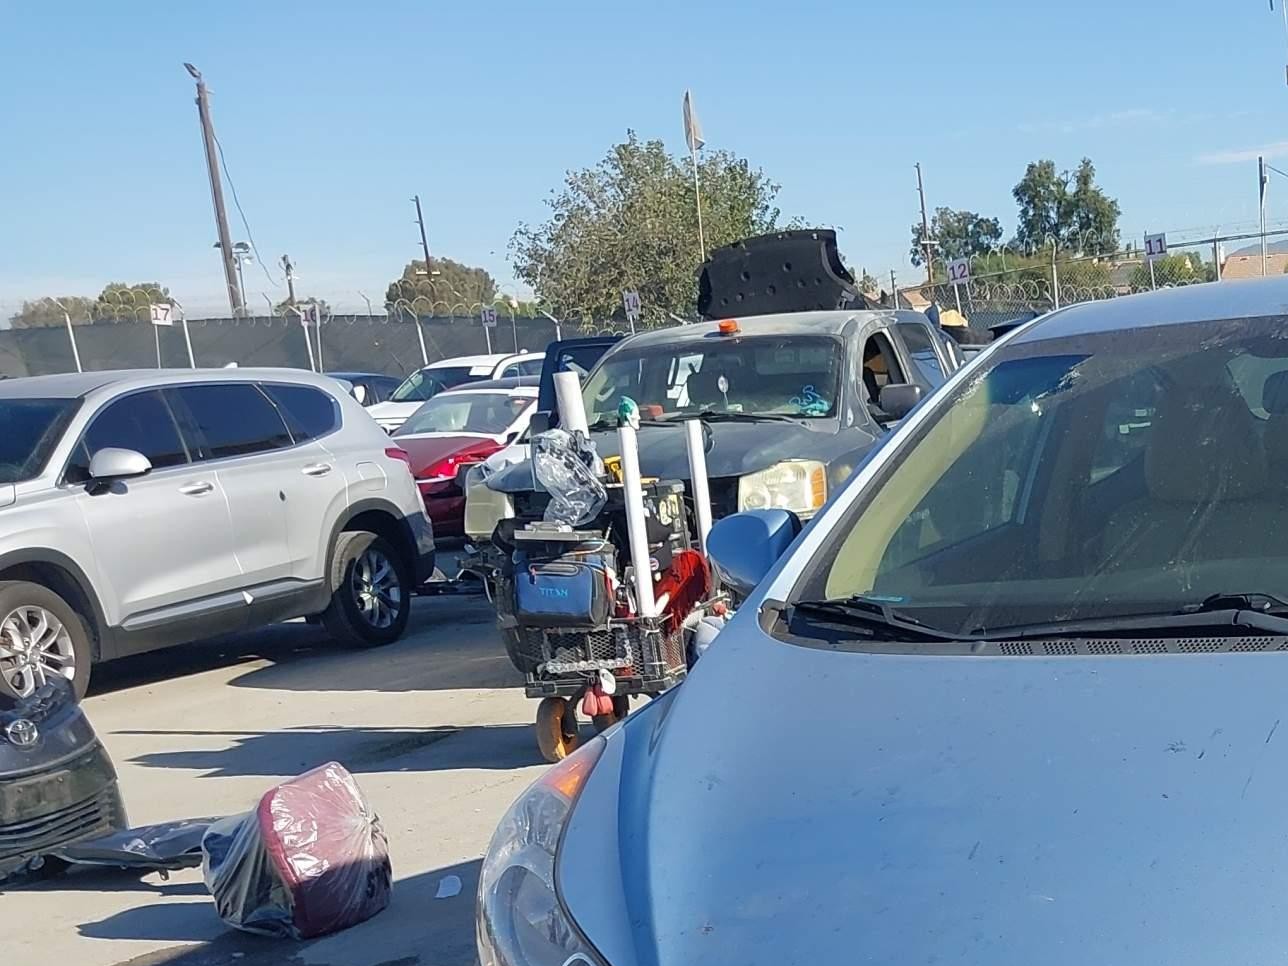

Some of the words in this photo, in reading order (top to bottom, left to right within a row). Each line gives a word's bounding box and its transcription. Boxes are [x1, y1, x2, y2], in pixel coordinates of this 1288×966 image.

[1145, 238, 1167, 255] 11
[949, 264, 968, 281] 12
[625, 297, 639, 312] 14
[152, 307, 170, 321] 17
[482, 310, 495, 323] 15
